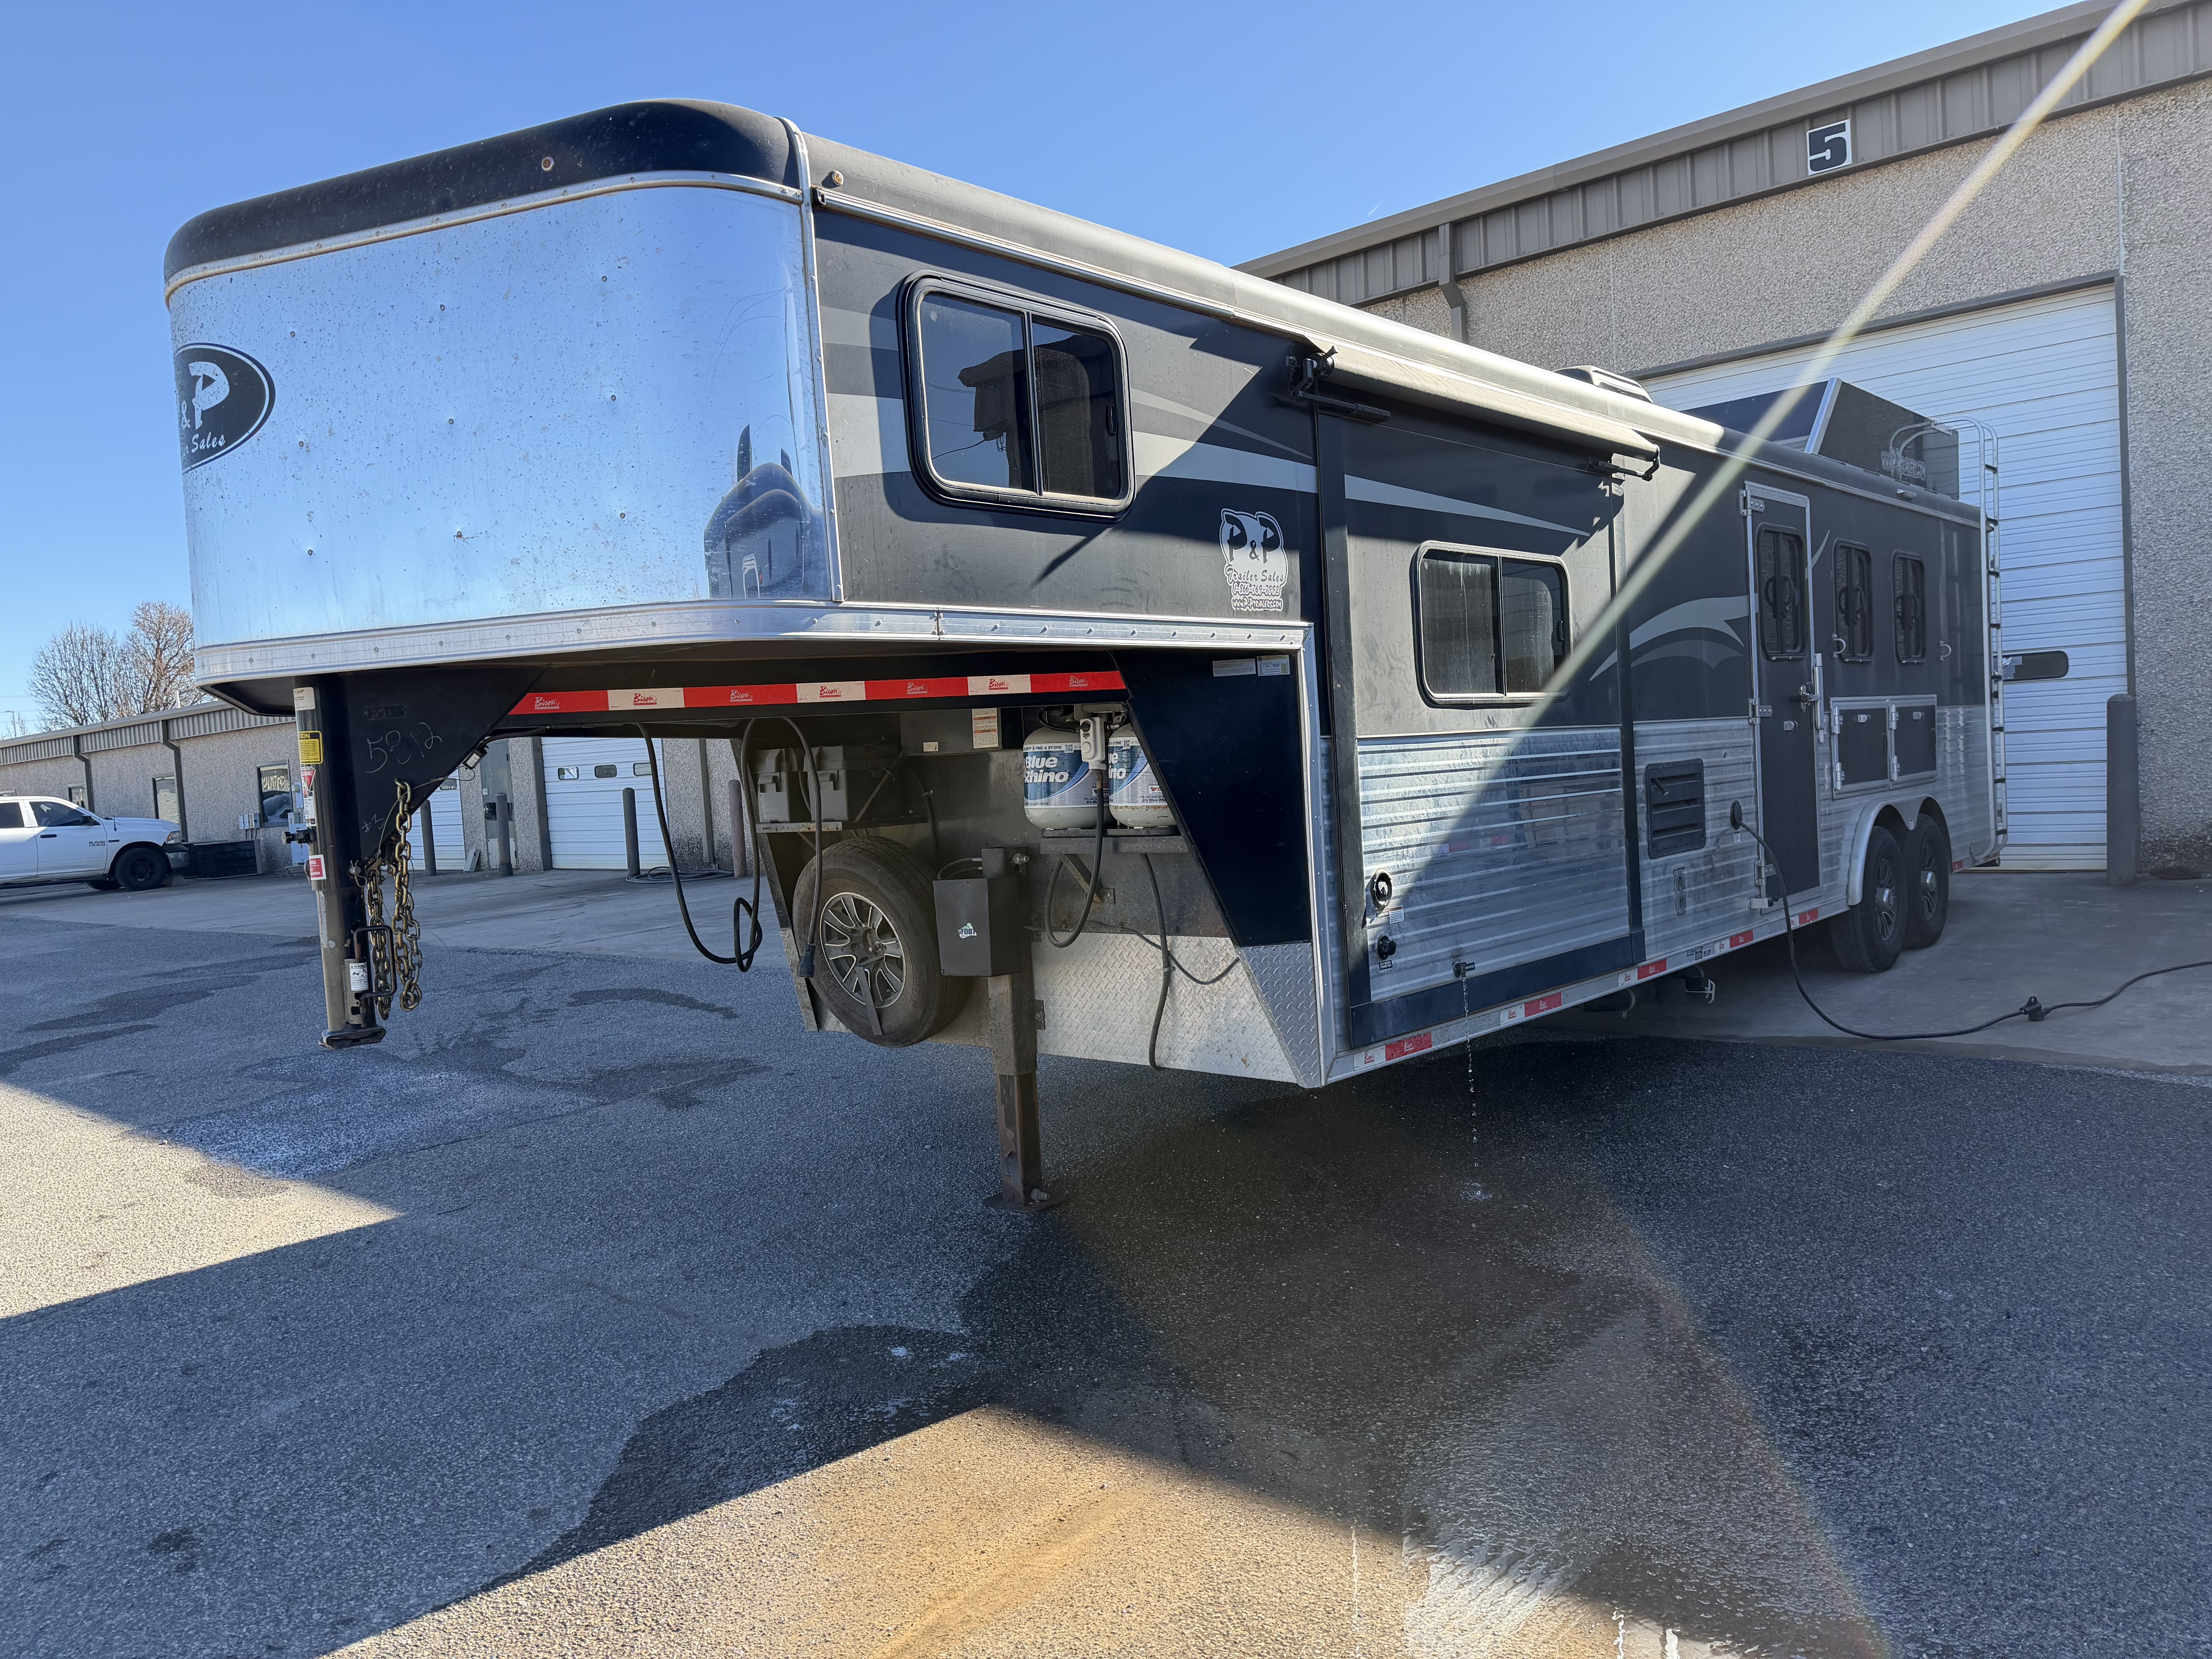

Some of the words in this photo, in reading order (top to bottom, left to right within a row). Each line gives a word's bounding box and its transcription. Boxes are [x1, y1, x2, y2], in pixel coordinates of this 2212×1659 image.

[1808, 122, 1847, 172] 5
[189, 361, 230, 429] P
[191, 432, 225, 453] Sales
[1224, 514, 1248, 562] P
[1249, 540, 1260, 561] &
[1258, 517, 1280, 564] P
[1227, 569, 1258, 582] Trailer
[1261, 569, 1284, 582] Sales
[1233, 582, 1280, 596] 1-866-769-7992
[730, 690, 749, 699] Bison
[819, 686, 837, 695] Bison
[534, 696, 556, 707] Bison
[633, 693, 653, 703] Bison
[1025, 756, 1058, 769] Blue
